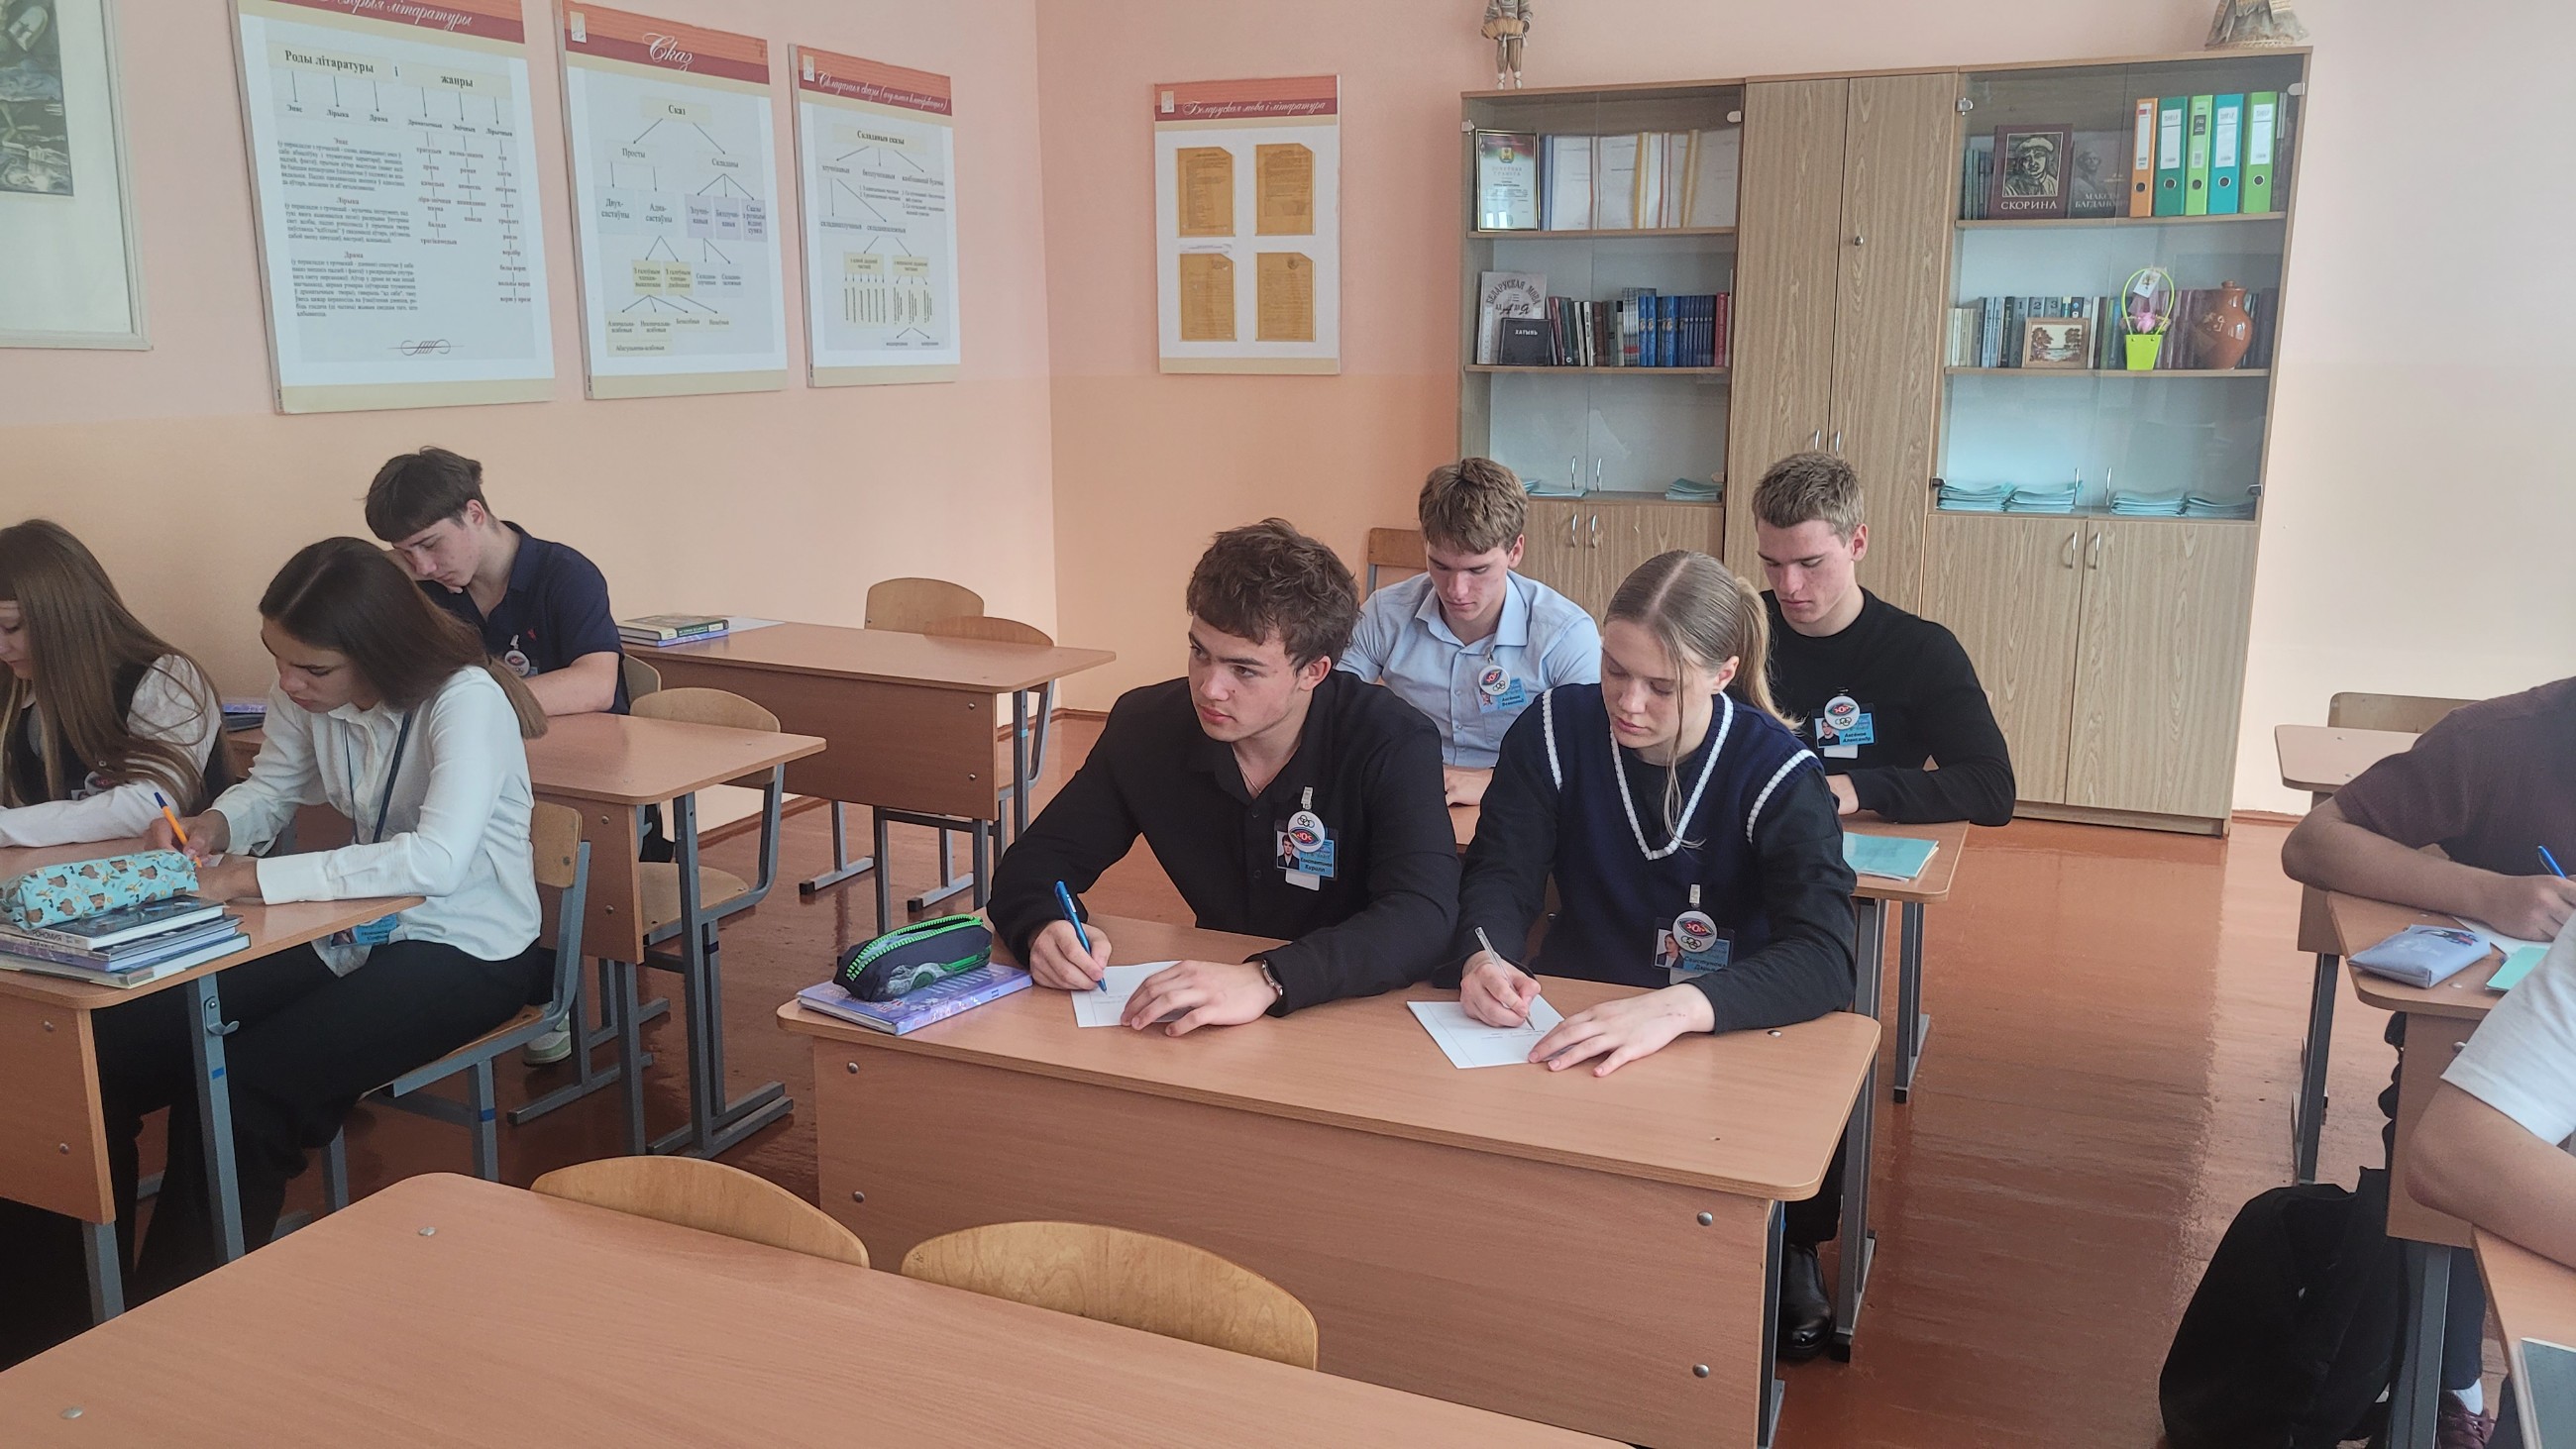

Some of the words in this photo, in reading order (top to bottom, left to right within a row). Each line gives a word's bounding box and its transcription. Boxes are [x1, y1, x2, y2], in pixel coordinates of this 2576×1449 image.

[386, 0, 473, 31] літаратуры
[643, 33, 695, 72] Сказ
[285, 50, 312, 64] Роды
[315, 55, 374, 74] літаратуры
[441, 74, 473, 87] жанры
[668, 104, 686, 116] Сказ
[1182, 101, 1241, 118] Беларуская
[1241, 102, 1264, 113] мова
[1265, 102, 1269, 111] і
[1270, 101, 1326, 115] літаратура
[622, 148, 646, 158] Просты
[2000, 199, 2058, 211] СКОРИНА
[1486, 278, 1526, 304] БЕЛАРУСКАЯ
[1526, 285, 1542, 305] МОВА
[2018, 301, 2022, 310] 1
